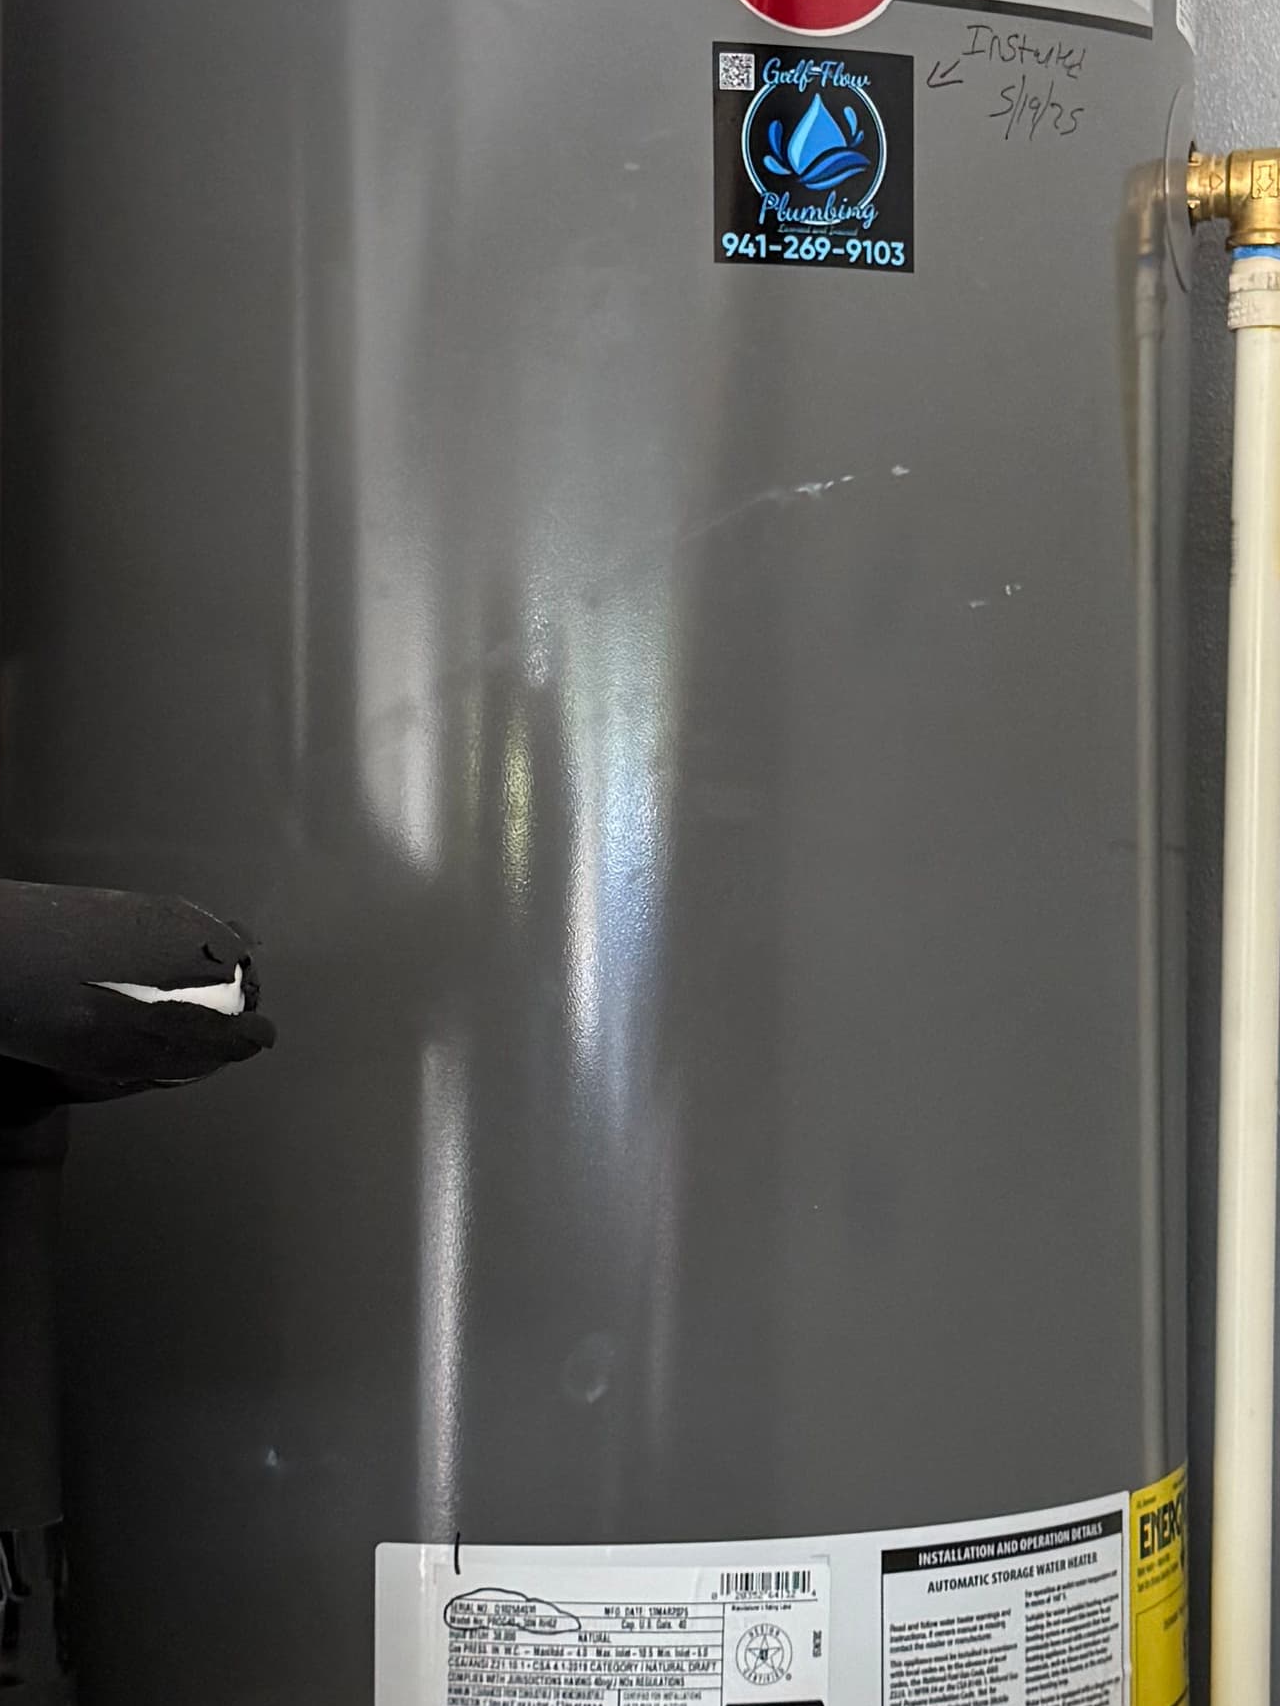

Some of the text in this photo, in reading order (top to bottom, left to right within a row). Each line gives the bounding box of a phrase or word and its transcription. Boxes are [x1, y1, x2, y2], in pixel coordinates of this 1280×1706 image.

[758, 190, 878, 229] Plumbing
[722, 232, 905, 266] 941-269-9103
[918, 1542, 996, 1567] INSTALLATION
[997, 1539, 1018, 1557] AND
[1020, 1530, 1070, 1553] OPERATION
[927, 1572, 990, 1594] AUTOMATIC
[992, 1564, 1035, 1585] STORAGE
[1036, 1558, 1067, 1576] WATER
[578, 1633, 611, 1644] NATURAL
